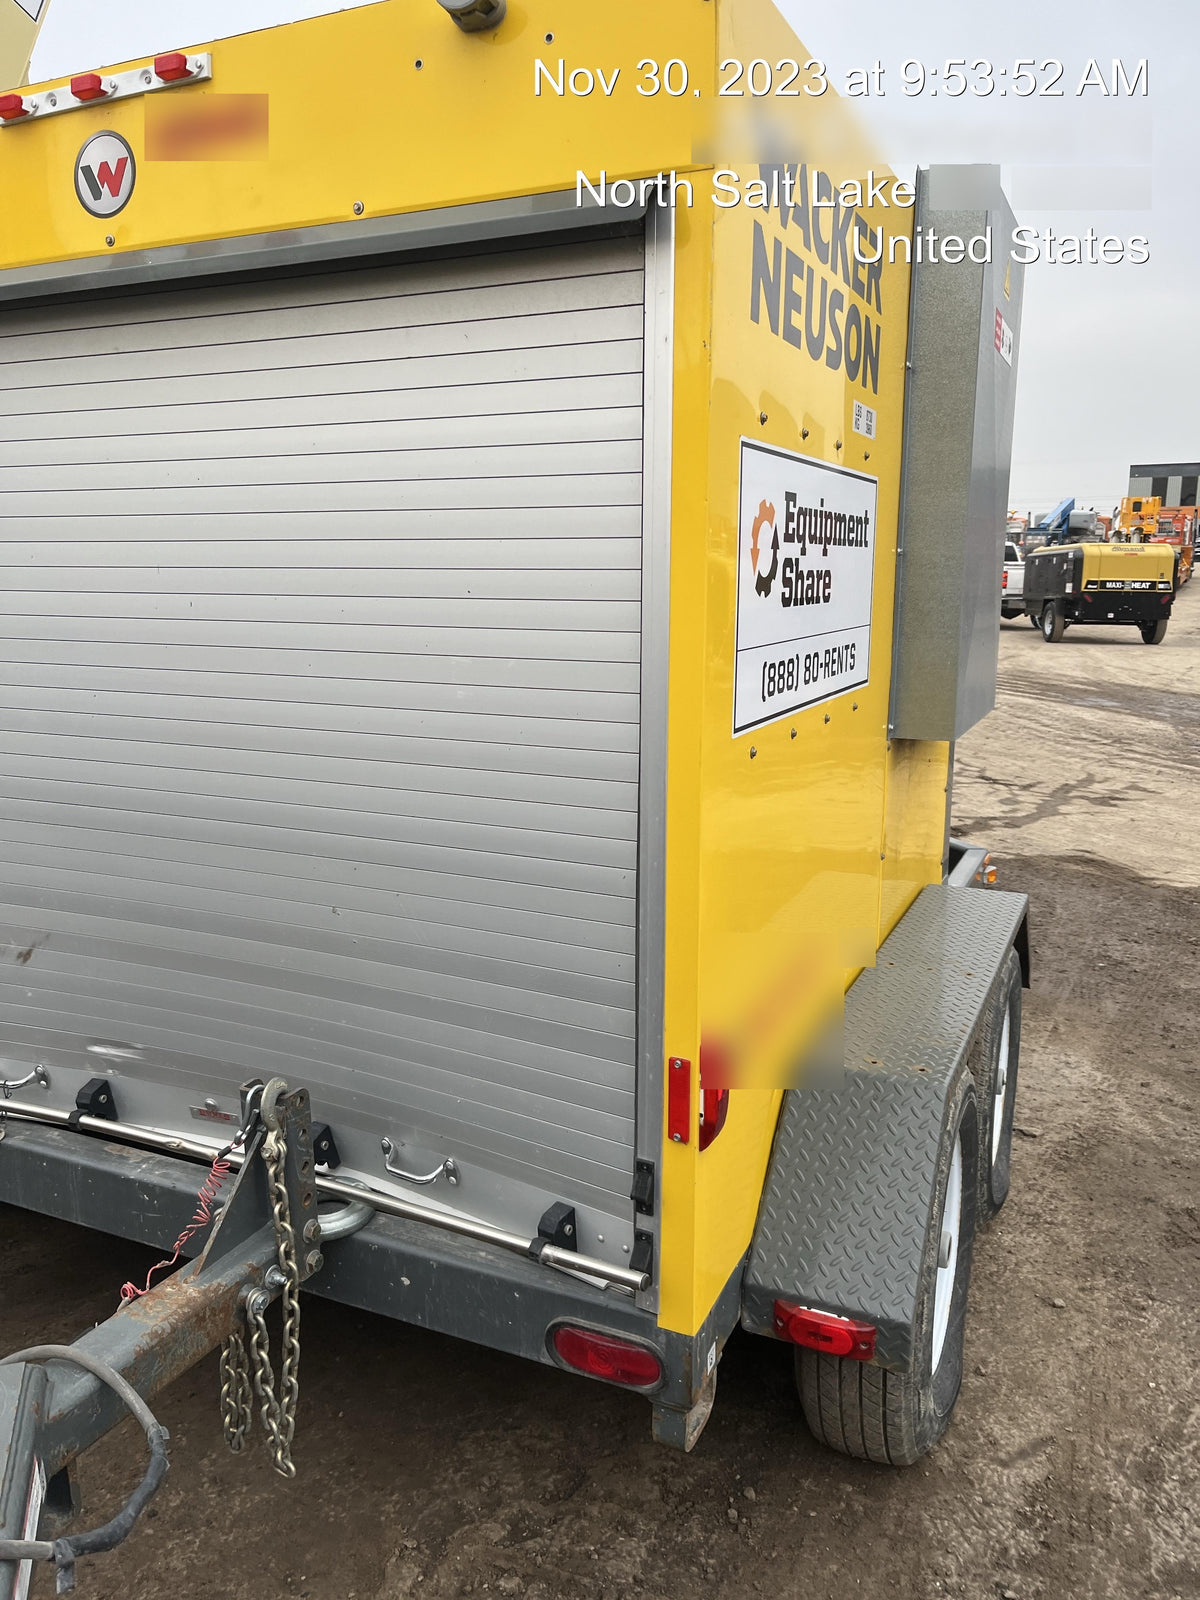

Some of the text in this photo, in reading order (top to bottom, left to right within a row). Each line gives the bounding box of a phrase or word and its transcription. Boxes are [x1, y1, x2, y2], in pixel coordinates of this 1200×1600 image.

[750, 219, 881, 395] NEUSON
[783, 491, 869, 557] Equipment
[781, 558, 831, 609] Share
[761, 643, 856, 702] (888) 80-RENTS
